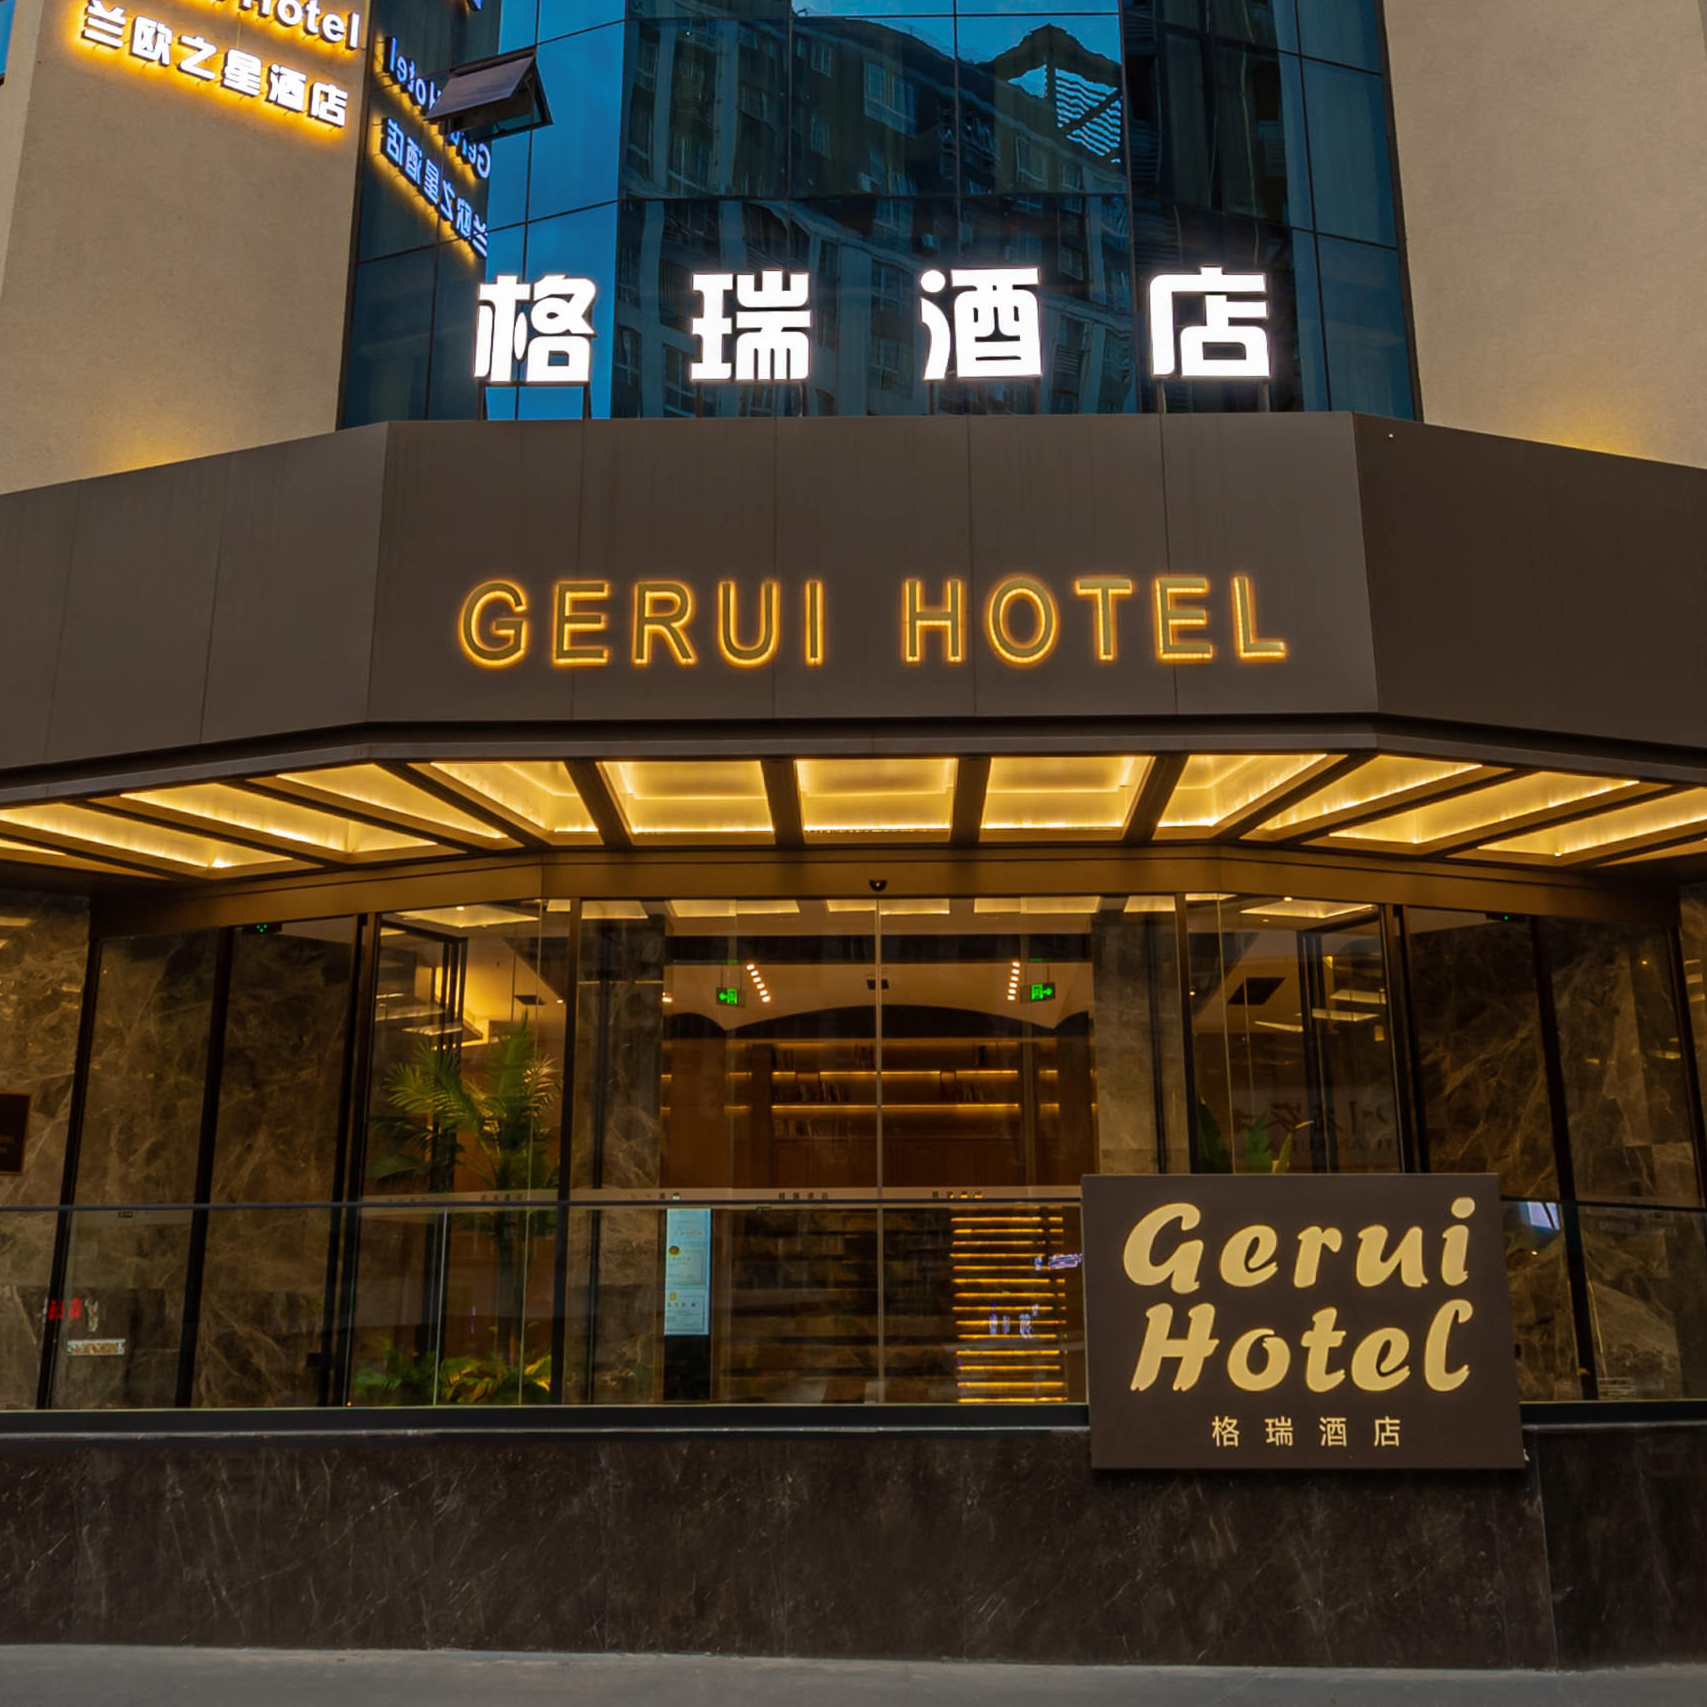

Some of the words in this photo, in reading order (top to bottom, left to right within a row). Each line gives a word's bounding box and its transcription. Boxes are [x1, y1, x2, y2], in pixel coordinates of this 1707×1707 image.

[473, 266, 1272, 385] 格瑞酒店
[457, 578, 825, 670] GERUI
[902, 575, 1289, 667] HOTEL
[1123, 1196, 1475, 1294] Gerui
[1129, 1298, 1474, 1393] Hotel
[1210, 1413, 1402, 1448] 格瑞酒店
